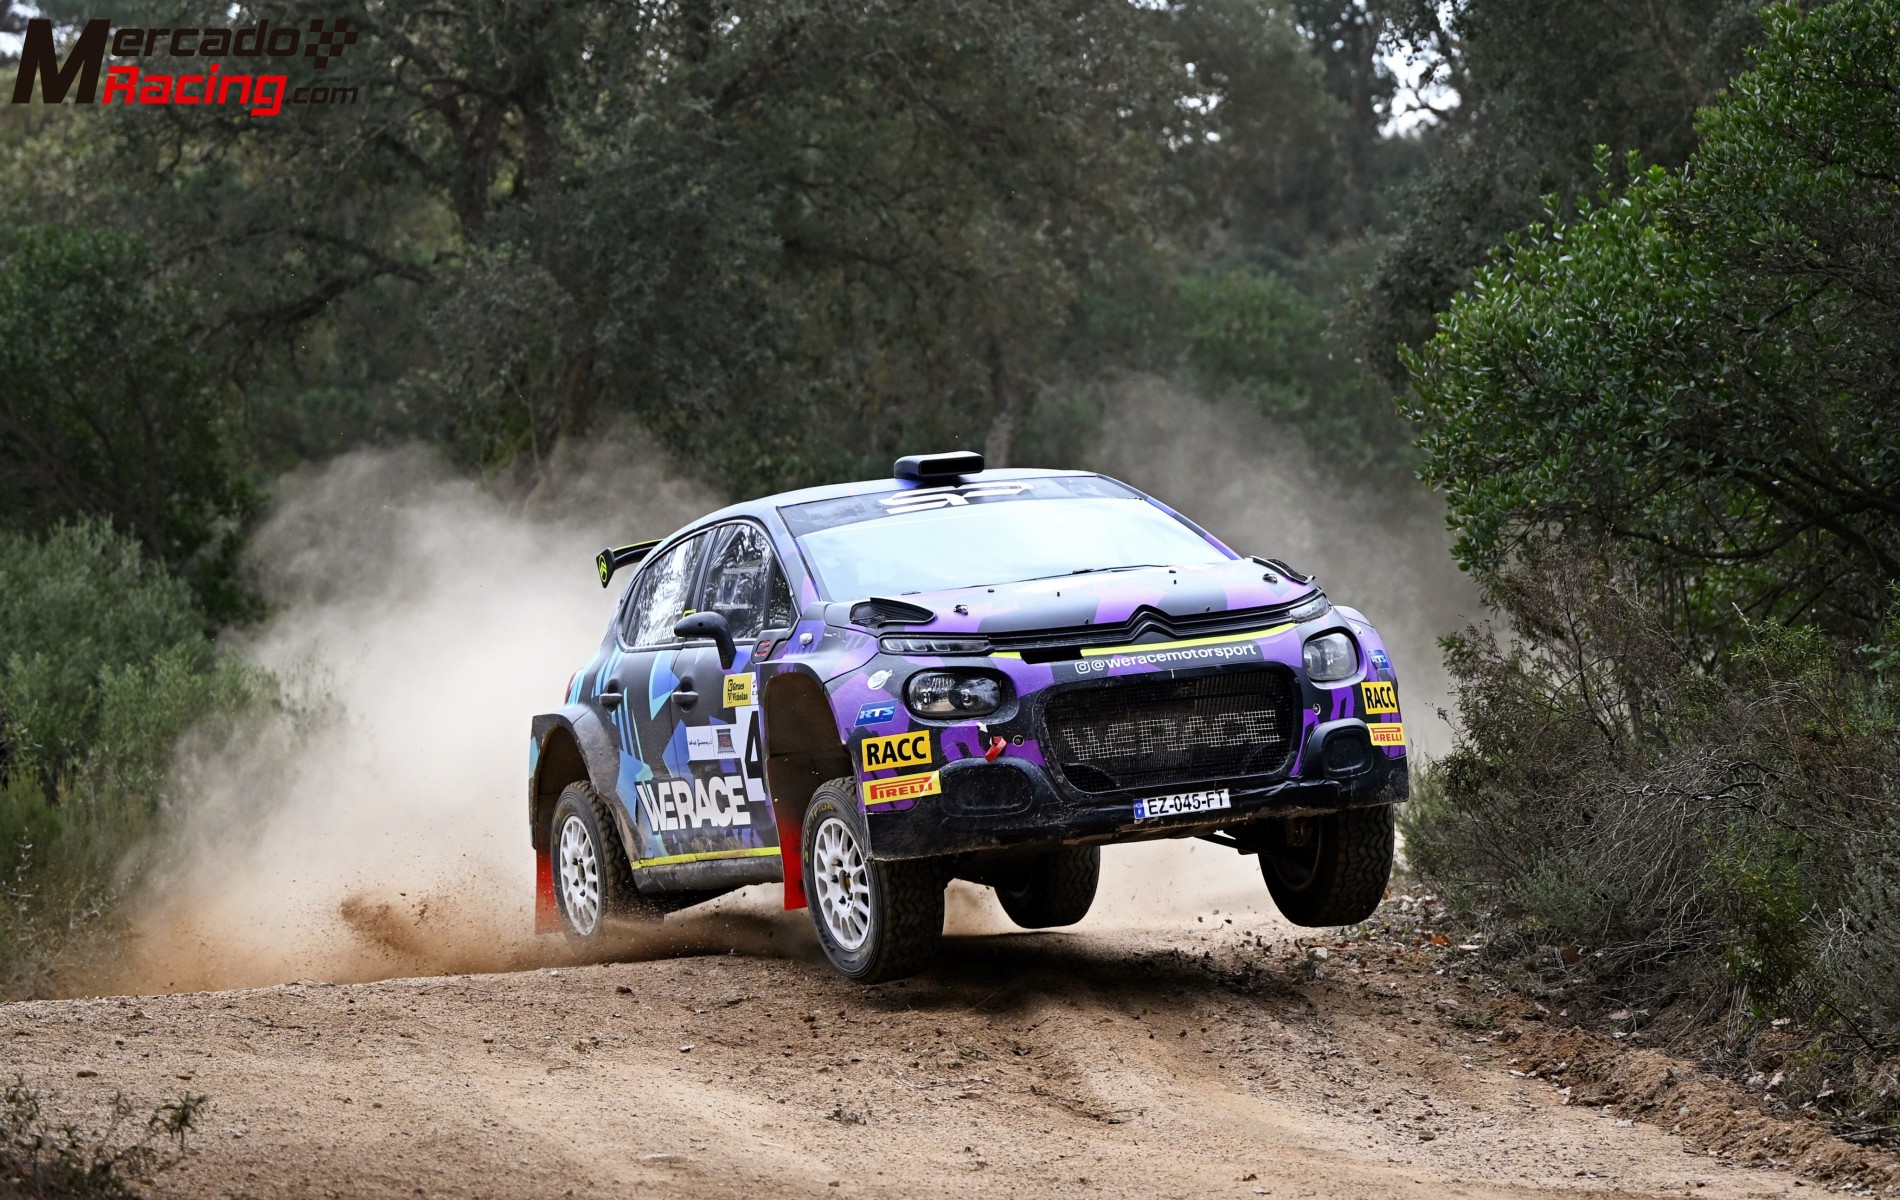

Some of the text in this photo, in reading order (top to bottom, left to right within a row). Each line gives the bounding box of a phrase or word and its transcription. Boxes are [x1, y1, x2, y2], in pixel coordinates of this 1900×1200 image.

[1091, 643, 1257, 671] @weracemotorsport
[1365, 686, 1395, 709] RACC
[858, 706, 896, 719] RTS
[1062, 710, 1281, 761] WERACE
[866, 736, 927, 766] RACC
[870, 776, 934, 800] PIRELLI
[636, 775, 751, 832] WERACE
[1147, 790, 1225, 815] EZ-045-FT
